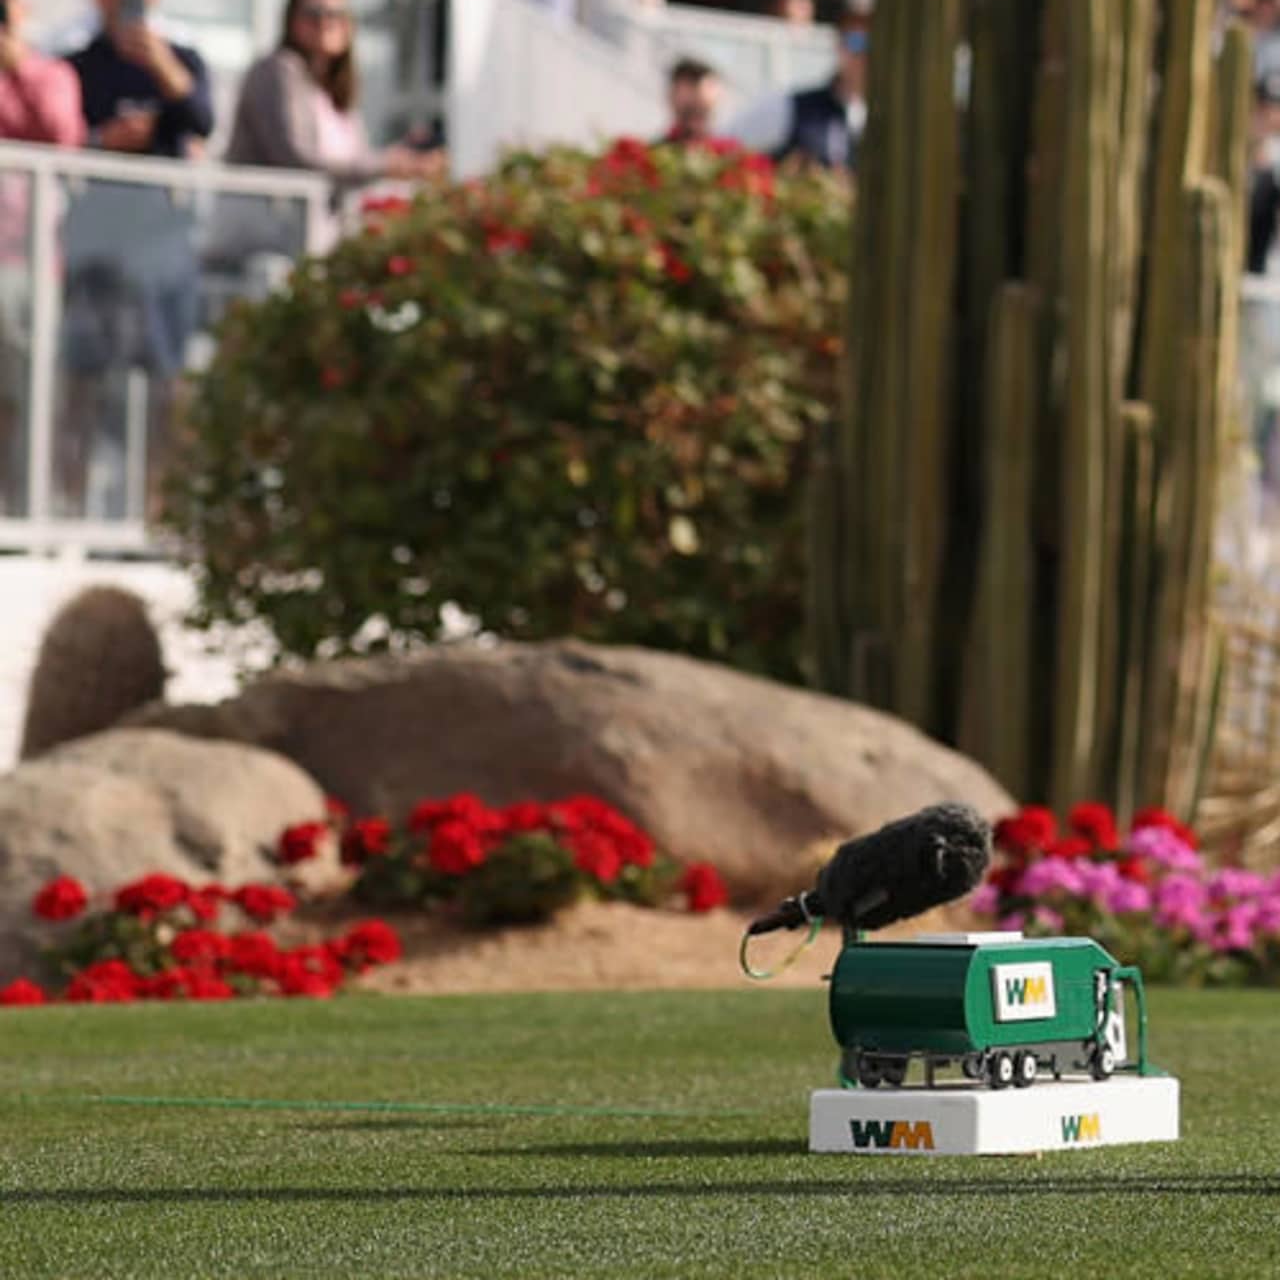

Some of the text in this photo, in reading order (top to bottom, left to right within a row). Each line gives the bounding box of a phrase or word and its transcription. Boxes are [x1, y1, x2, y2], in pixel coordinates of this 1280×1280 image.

[1005, 976, 1048, 1006] WM
[850, 1119, 935, 1150] WM
[1061, 1113, 1101, 1143] WM
